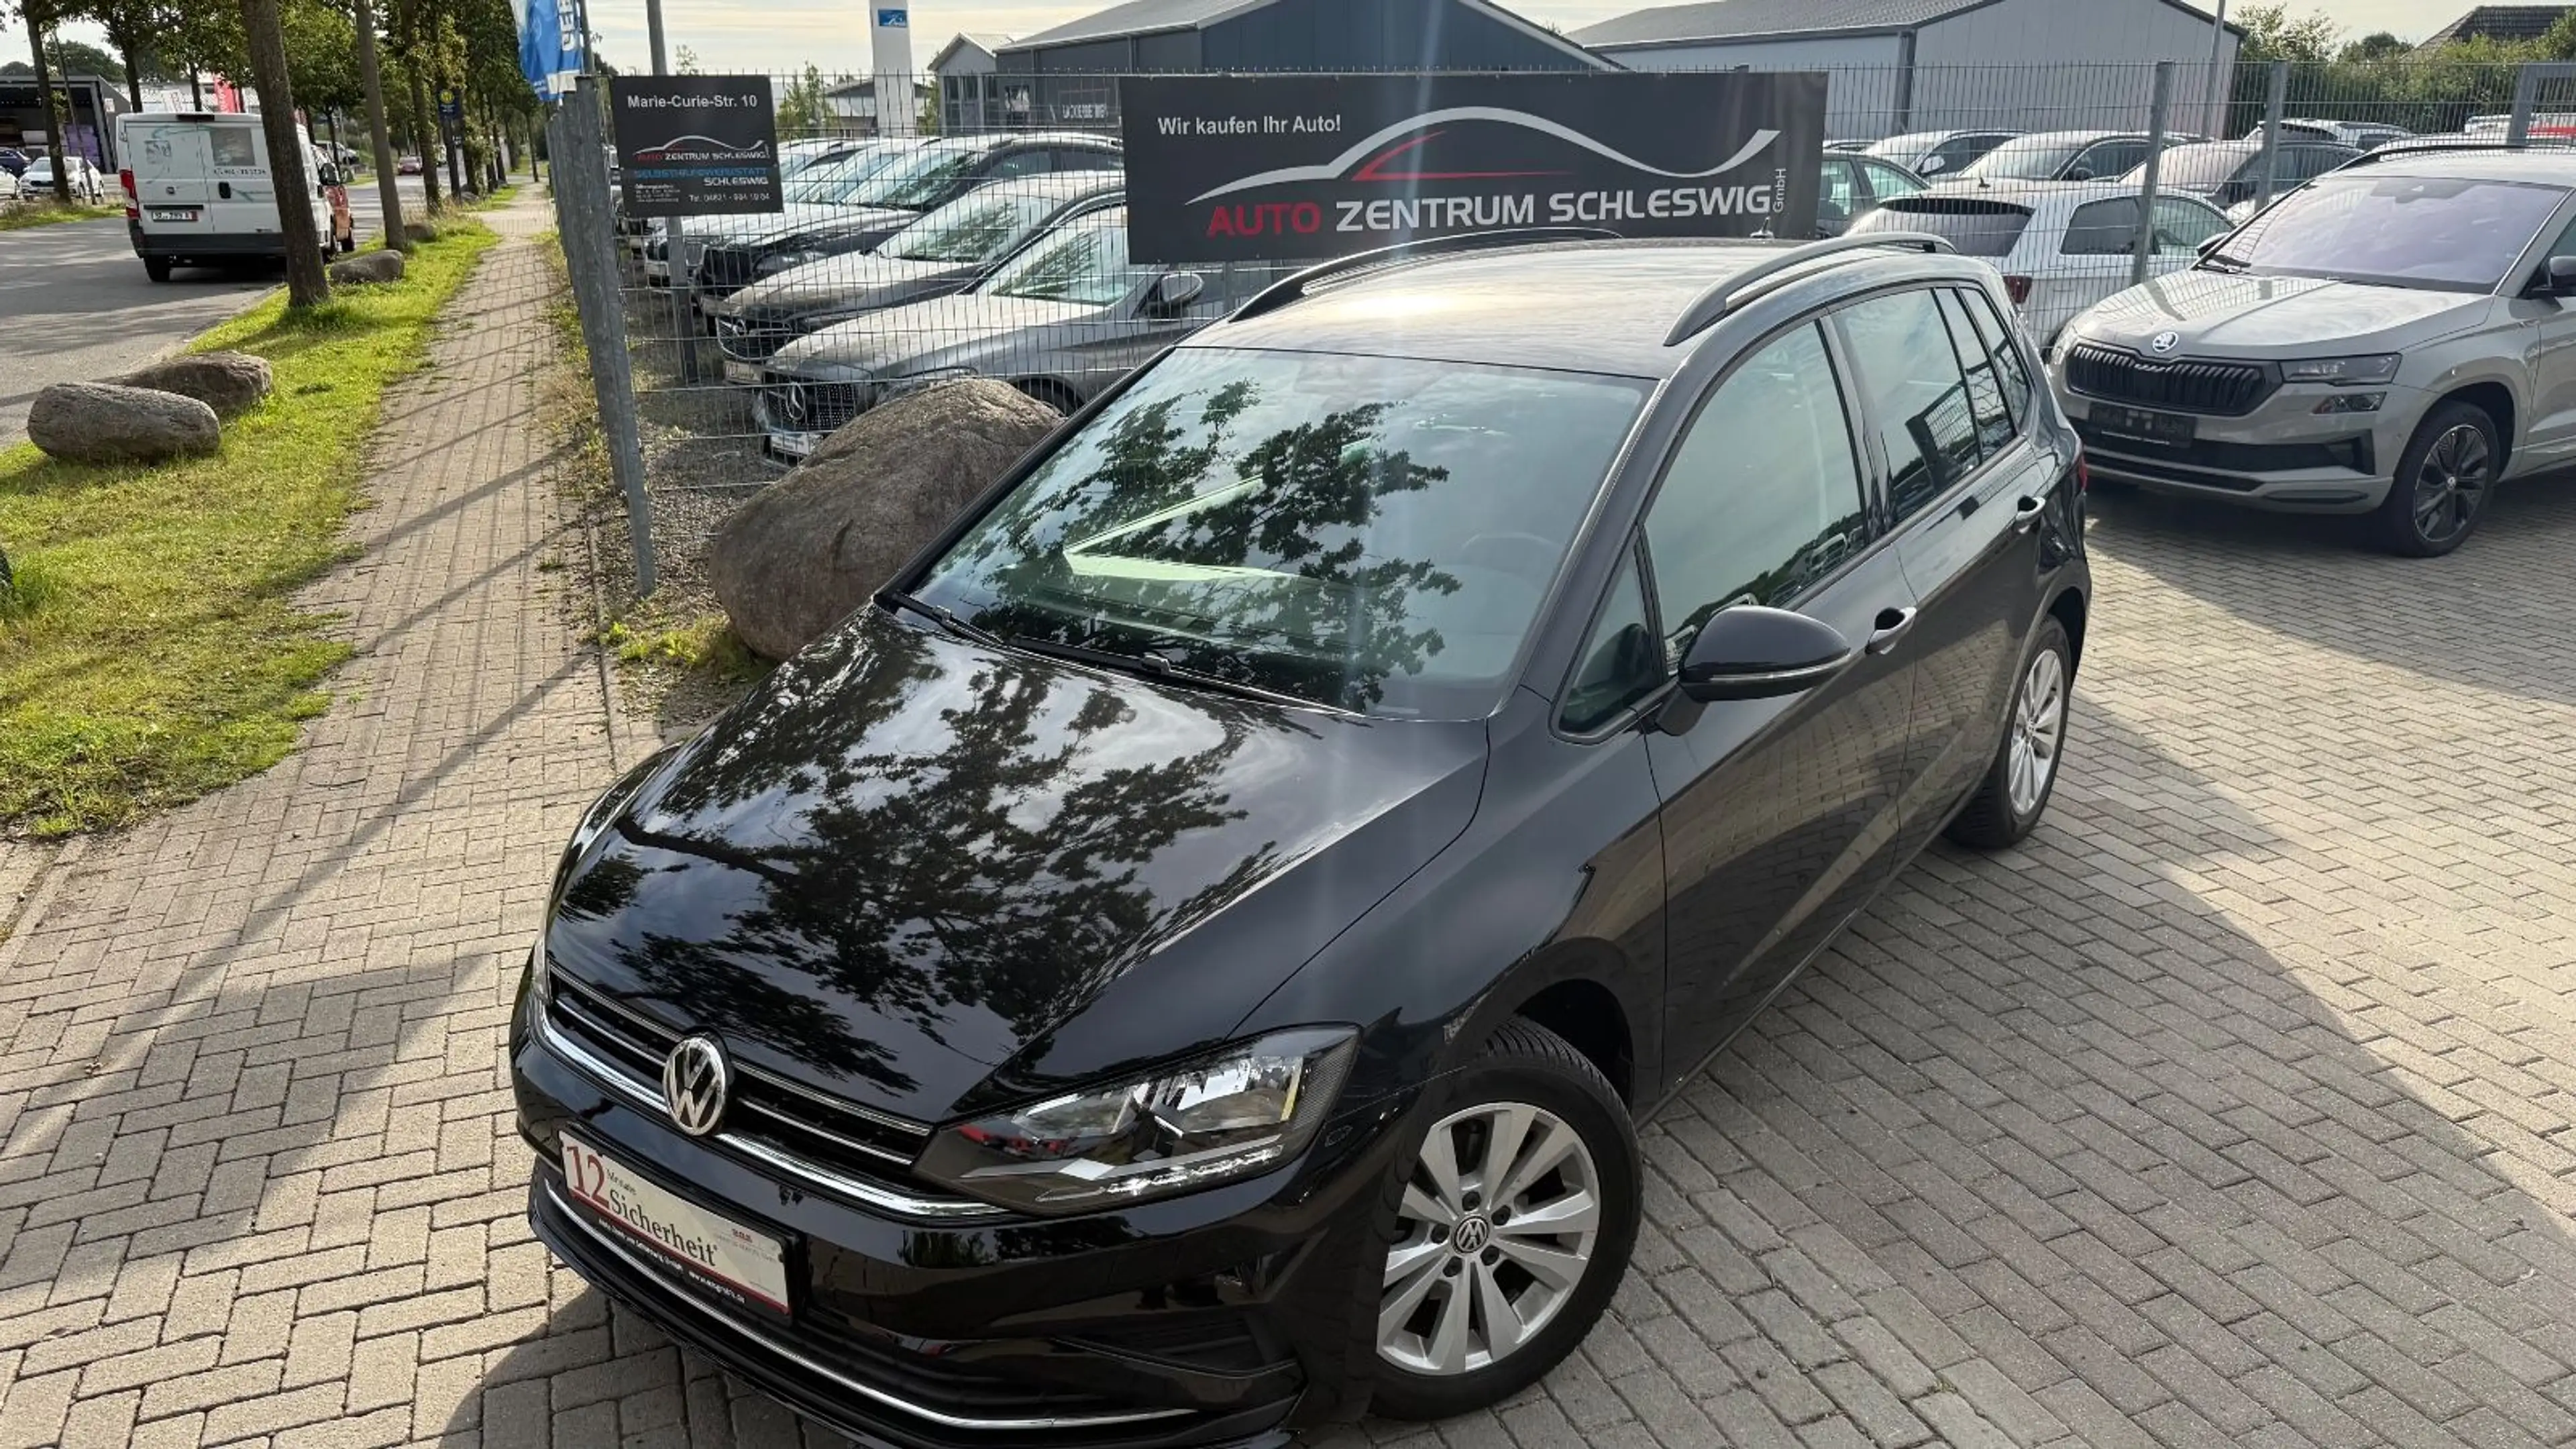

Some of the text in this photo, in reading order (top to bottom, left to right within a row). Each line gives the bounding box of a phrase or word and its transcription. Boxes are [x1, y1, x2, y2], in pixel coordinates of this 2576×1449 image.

[627, 94, 758, 108] Marie-Curie-Str. 10
[1157, 114, 1341, 134] Wir kaufen Ihr Auto!
[665, 152, 710, 161] ZENTRUM
[712, 151, 765, 160] SCHLESWIG
[704, 177, 769, 186] SCHLESWIG
[1774, 168, 1786, 213] GmbH
[1208, 184, 1771, 237] AUTO ZENTRUM SCHLESWIG
[567, 1145, 609, 1207] 12
